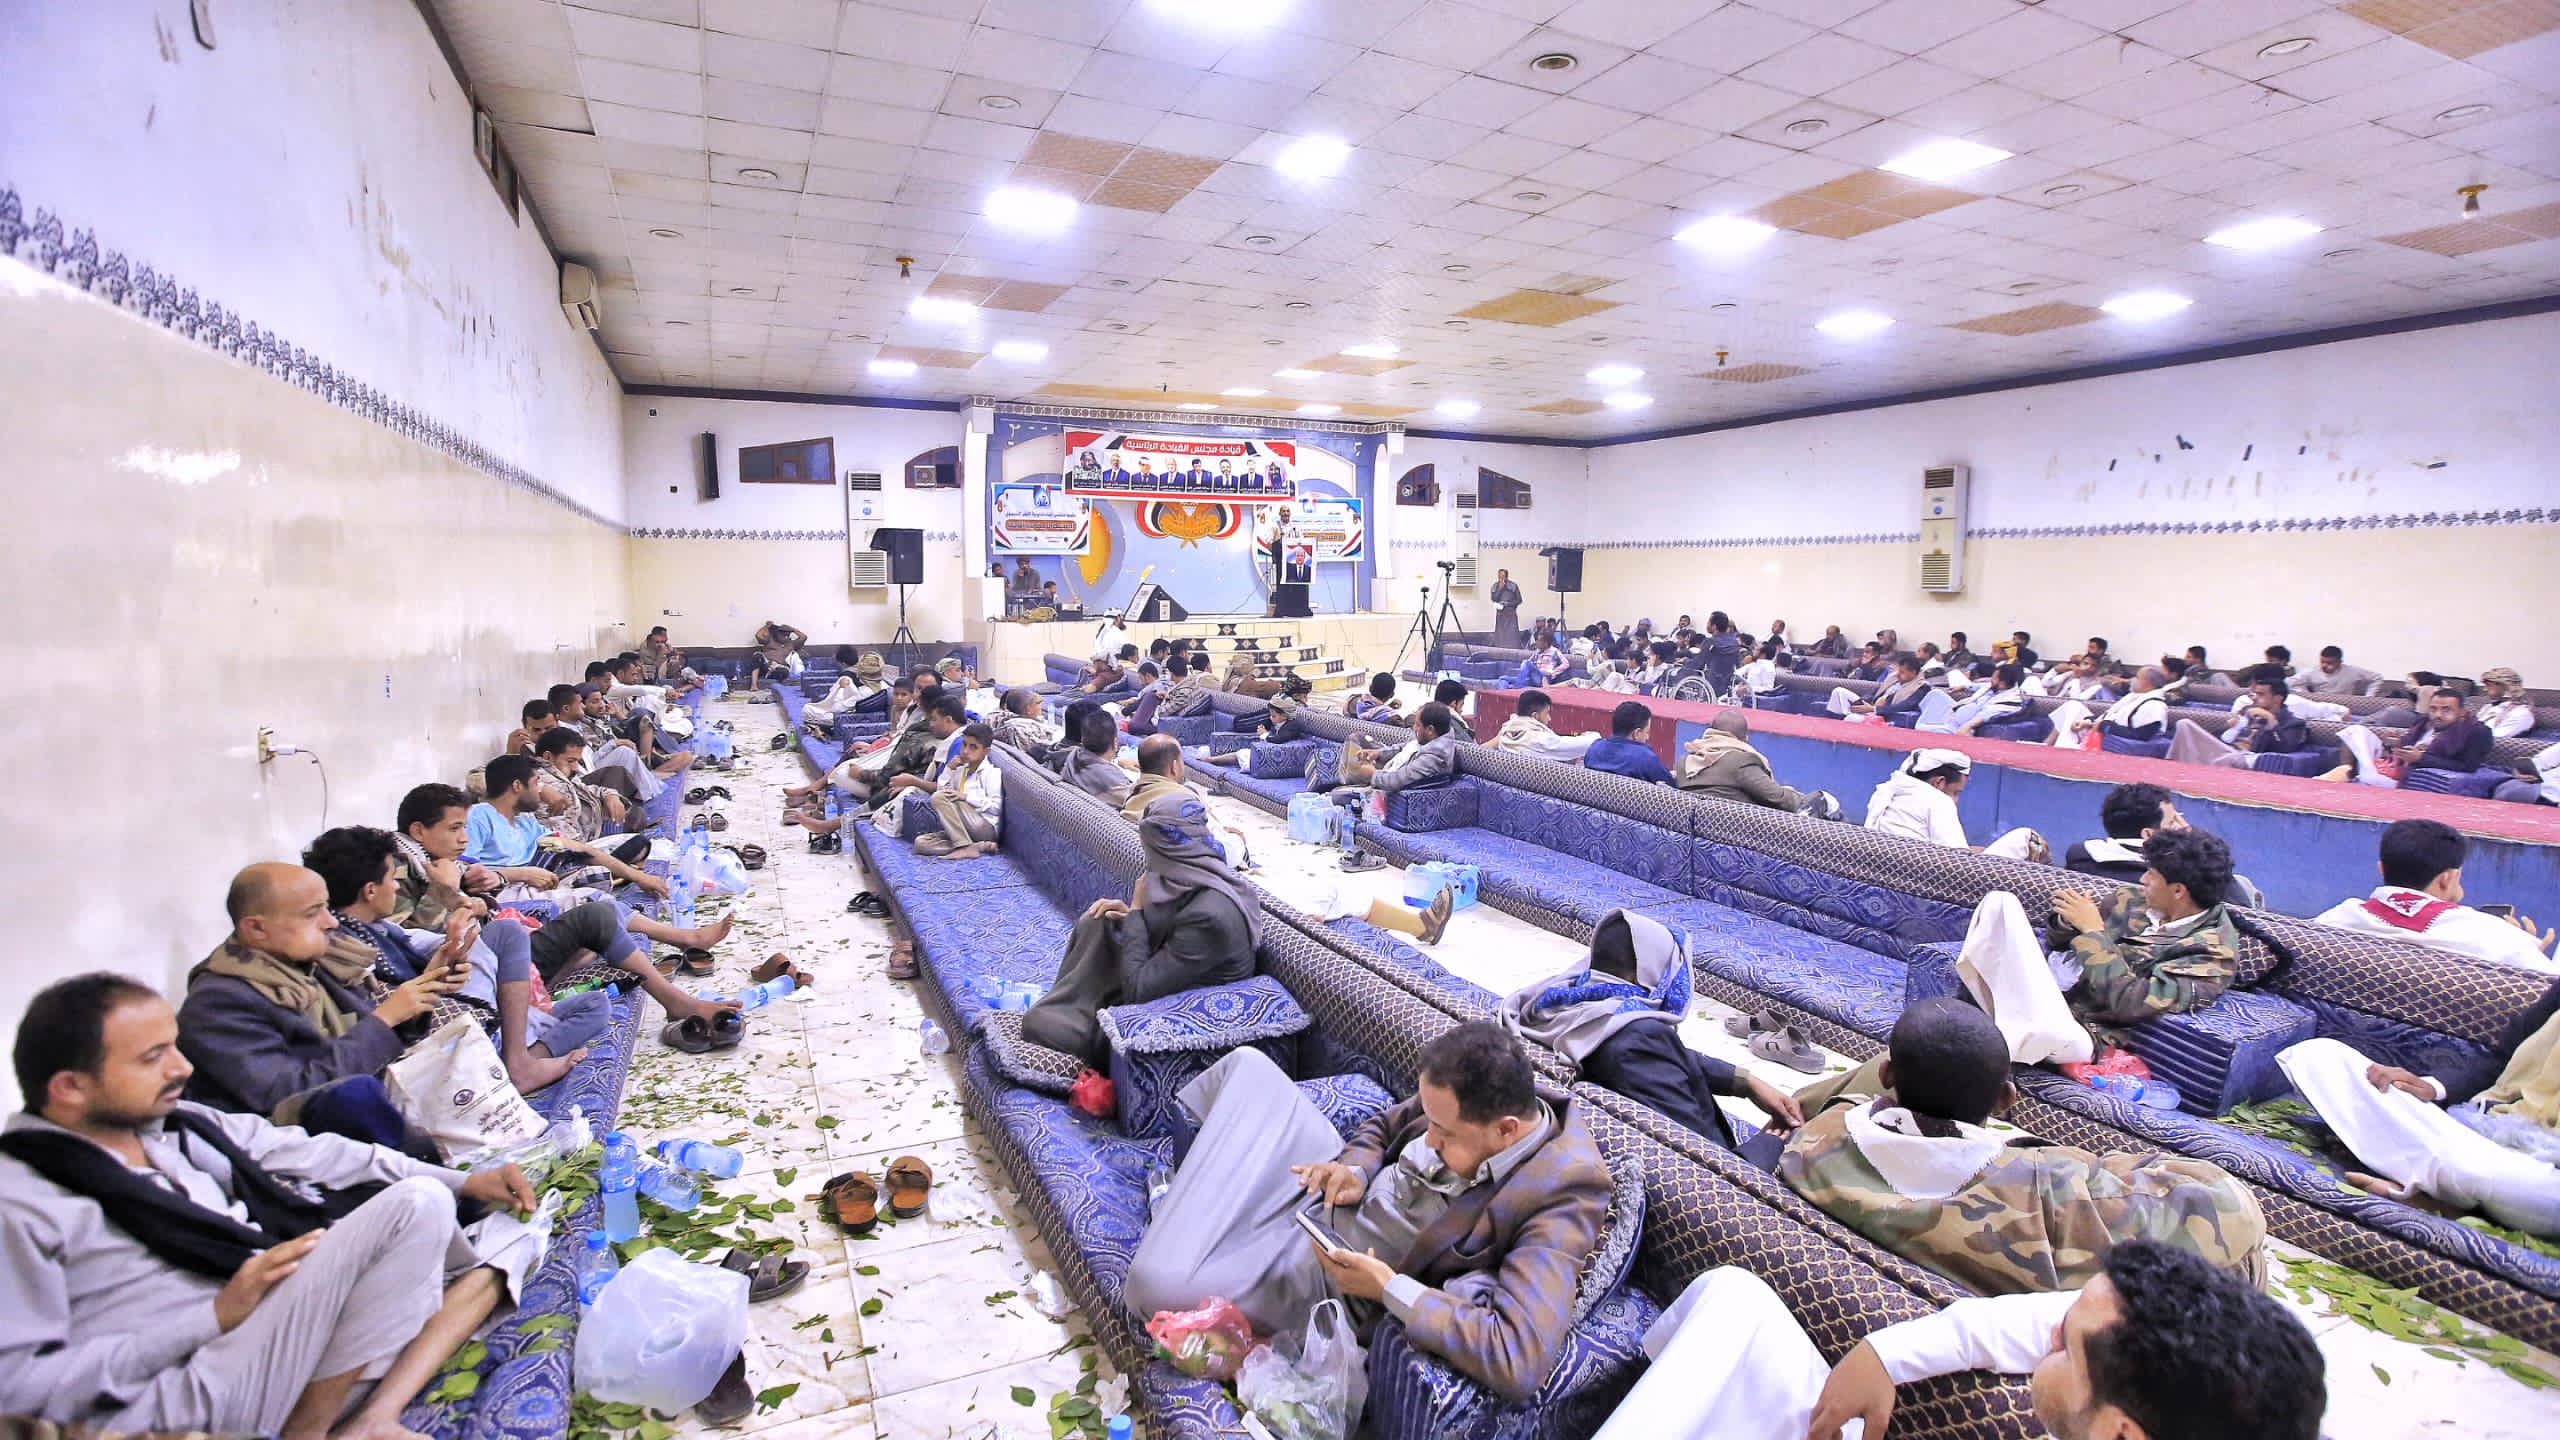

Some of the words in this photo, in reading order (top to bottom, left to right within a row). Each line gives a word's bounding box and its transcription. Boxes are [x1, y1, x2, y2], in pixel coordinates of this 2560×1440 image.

[1160, 442, 1189, 452] القيادة
[1190, 445, 1217, 456] مجلس
[1219, 444, 1241, 454] قيادة
